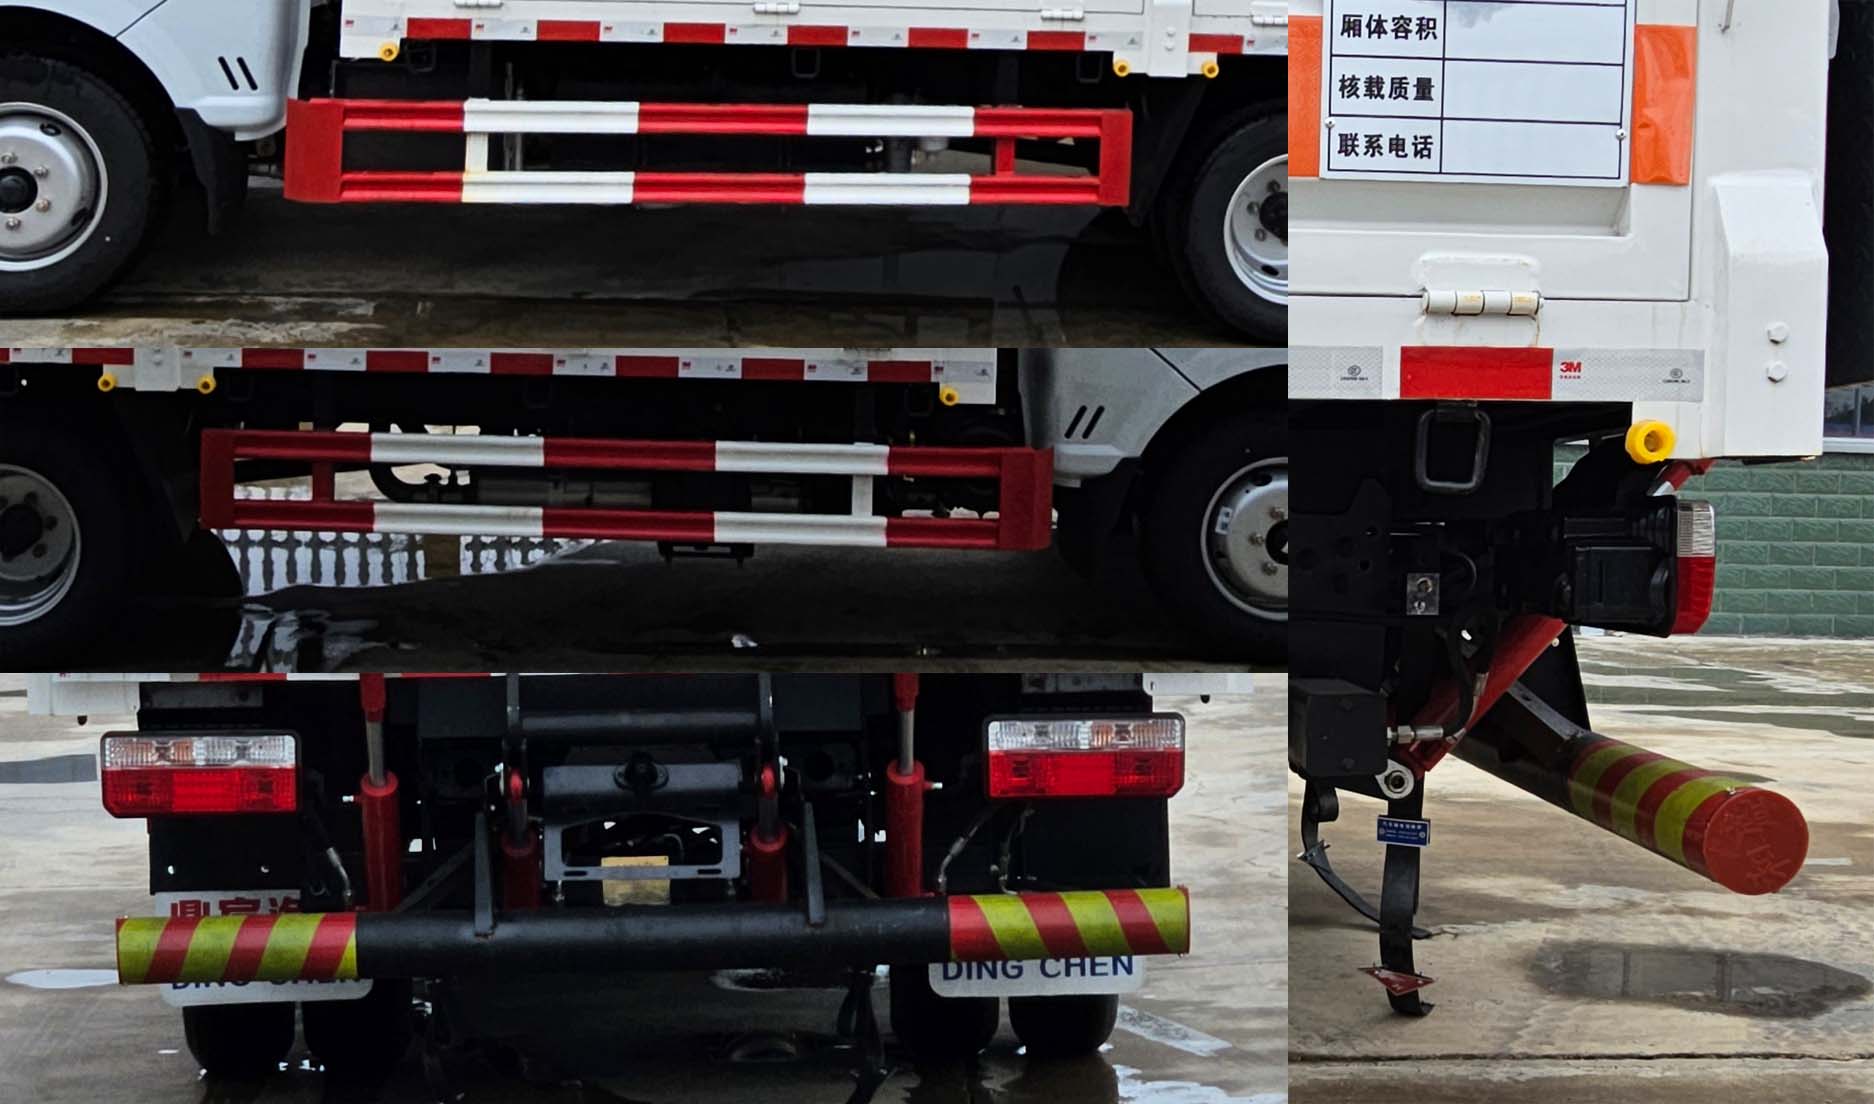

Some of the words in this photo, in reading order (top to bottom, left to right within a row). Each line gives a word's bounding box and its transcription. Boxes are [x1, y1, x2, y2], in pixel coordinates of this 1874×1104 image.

[1340, 13, 1438, 41] 厢体容积
[1338, 74, 1435, 101] 核载质量
[1337, 132, 1434, 160] 联系电话
[1560, 361, 1582, 373] 3M
[942, 960, 1024, 981] DING
[1040, 955, 1134, 978] CHEN
